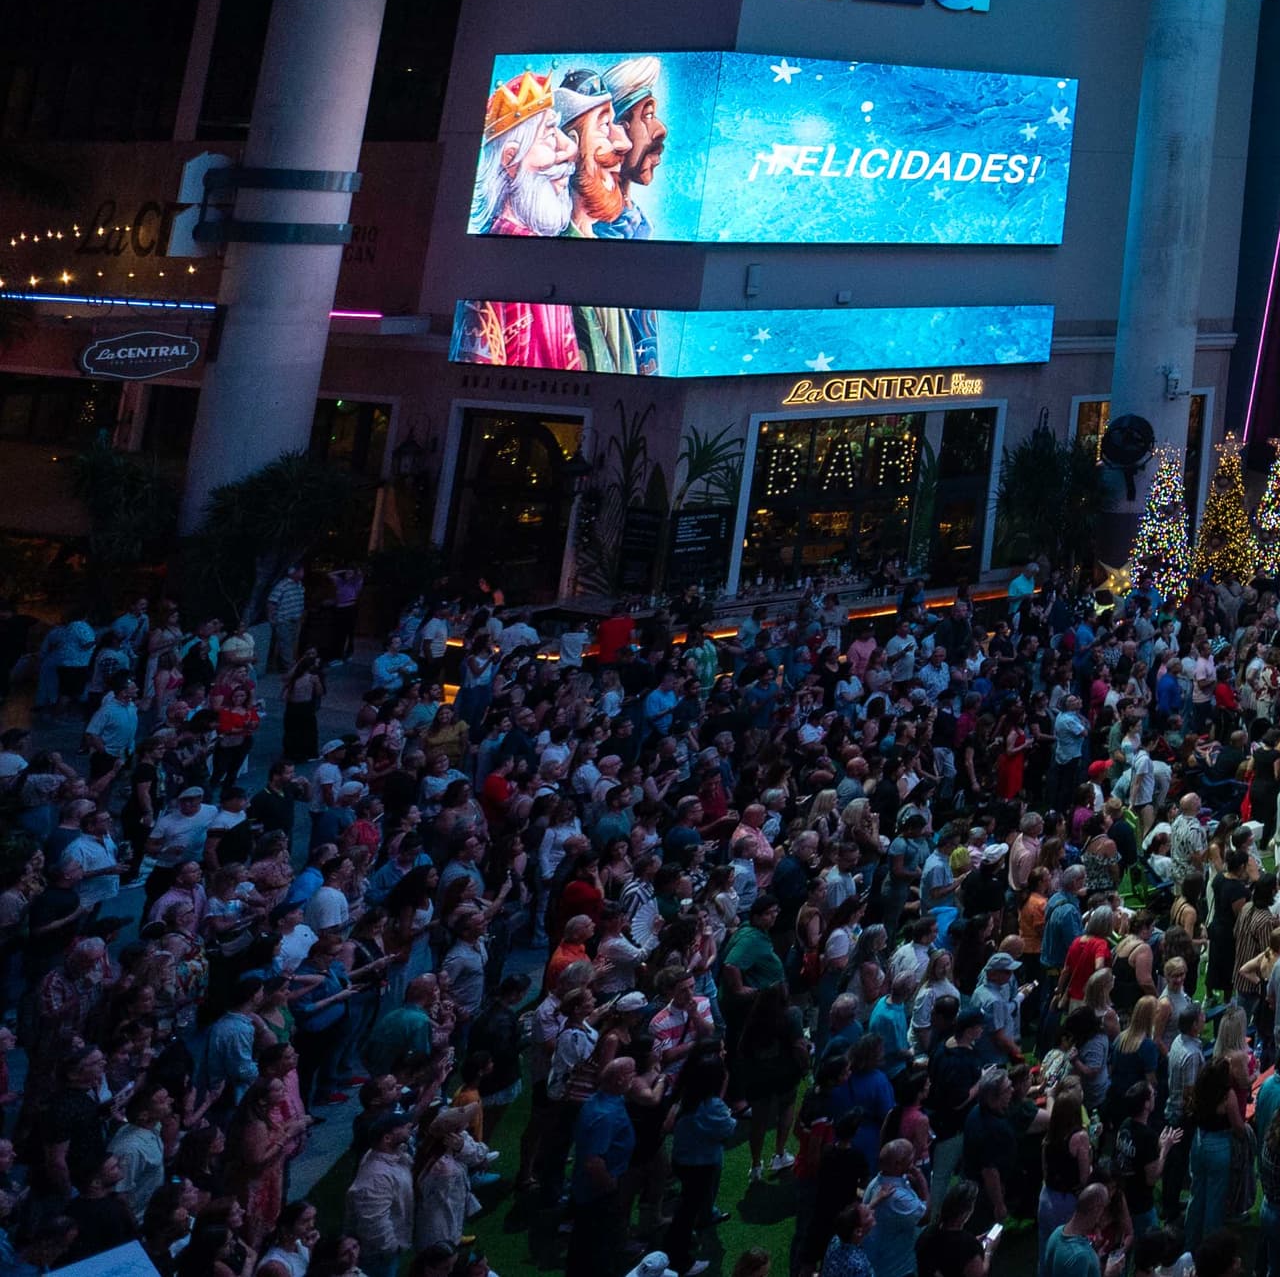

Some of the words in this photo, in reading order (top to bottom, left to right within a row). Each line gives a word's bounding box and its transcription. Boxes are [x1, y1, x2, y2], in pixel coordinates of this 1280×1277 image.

[117, 344, 190, 360] CENTRAL
[823, 374, 951, 402] CENTRAL
[765, 440, 909, 496] BAR
